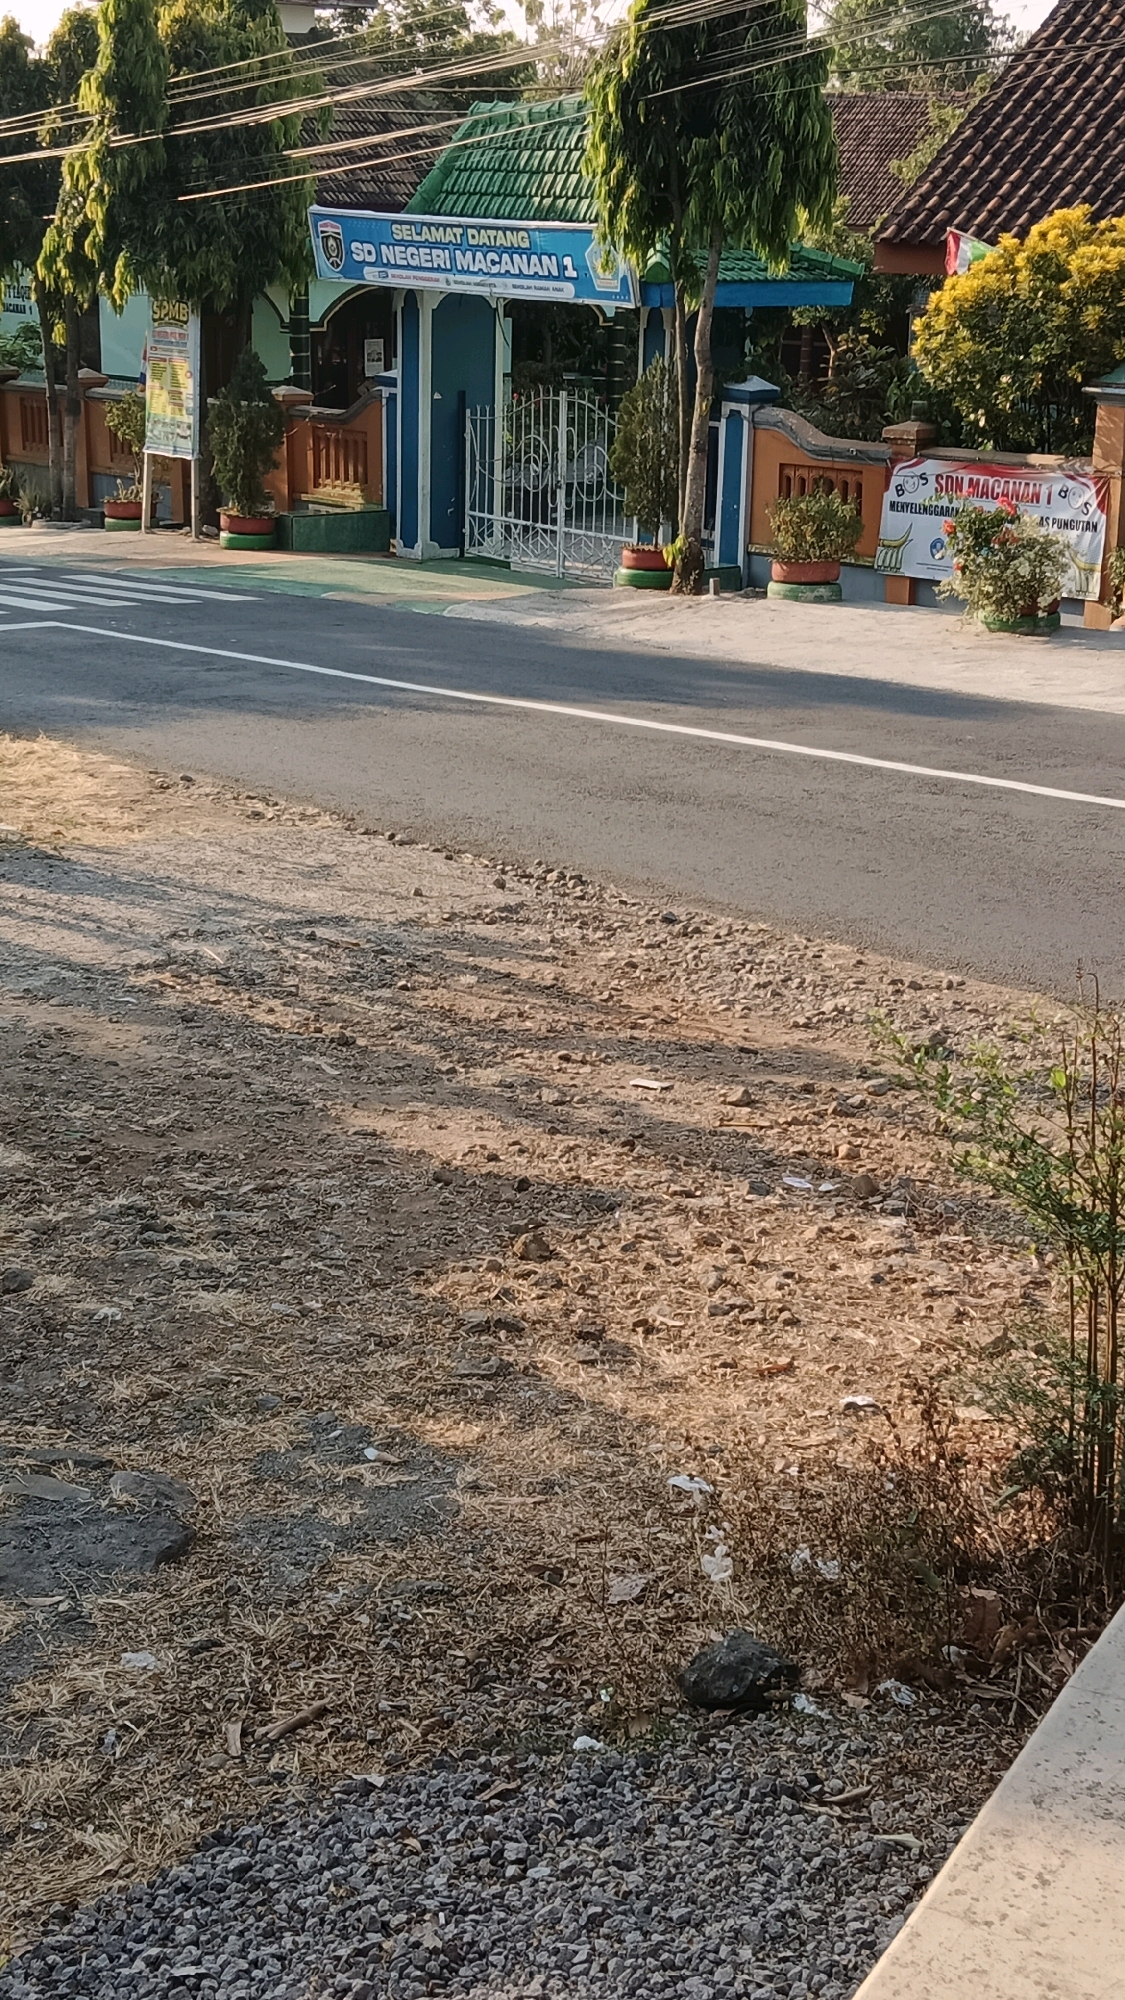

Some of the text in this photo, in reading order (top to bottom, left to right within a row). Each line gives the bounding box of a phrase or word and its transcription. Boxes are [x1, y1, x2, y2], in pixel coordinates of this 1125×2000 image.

[391, 224, 530, 249] SELAMAT DATANG
[351, 243, 577, 278] SD NEGERI MACANAN 1
[152, 300, 189, 322] SPMB
[934, 474, 1053, 505] SDN MACANAN 1
[889, 500, 960, 518] MENYELENGGARAK
[1051, 517, 1098, 533] PUNGUTAN
